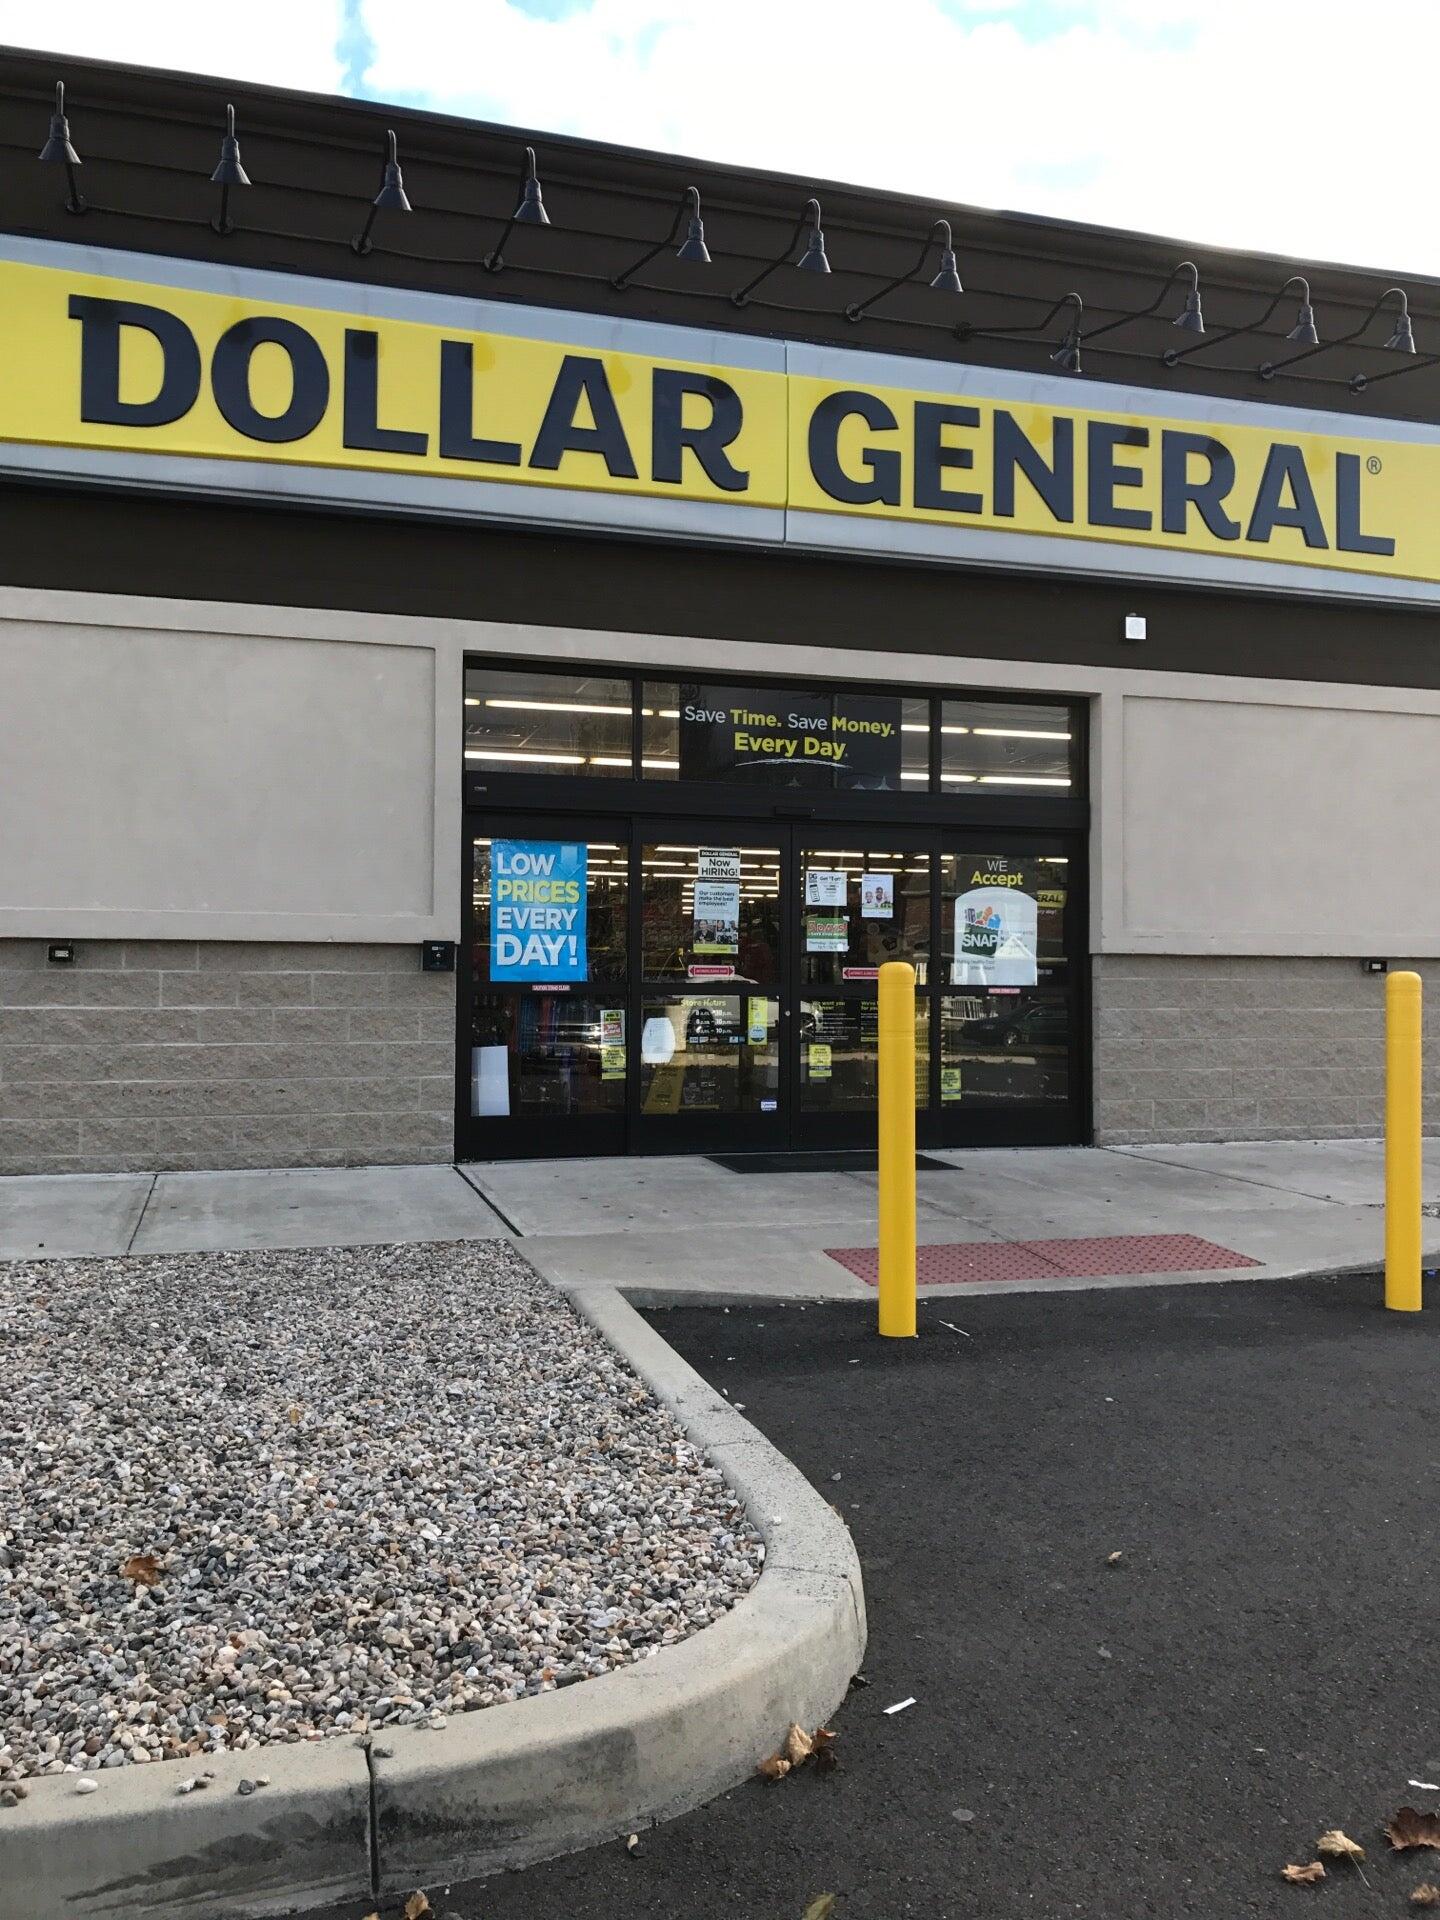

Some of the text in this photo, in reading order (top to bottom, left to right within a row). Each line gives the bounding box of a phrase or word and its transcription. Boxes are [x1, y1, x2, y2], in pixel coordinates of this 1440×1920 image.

[69, 294, 749, 491] DOLLAR
[685, 706, 895, 738] Save Time. Save Money.
[734, 732, 798, 757] Every
[497, 852, 556, 876] LOW
[701, 867, 738, 877] HIRING!
[709, 858, 731, 867] Now
[987, 860, 1009, 872] WE
[970, 871, 1024, 887] Accept
[497, 879, 580, 904] PRICES
[497, 907, 578, 931] EVERY
[497, 934, 578, 966] DAY!
[962, 934, 997, 948] SNAP
[680, 998, 727, 1007] Store Hours
